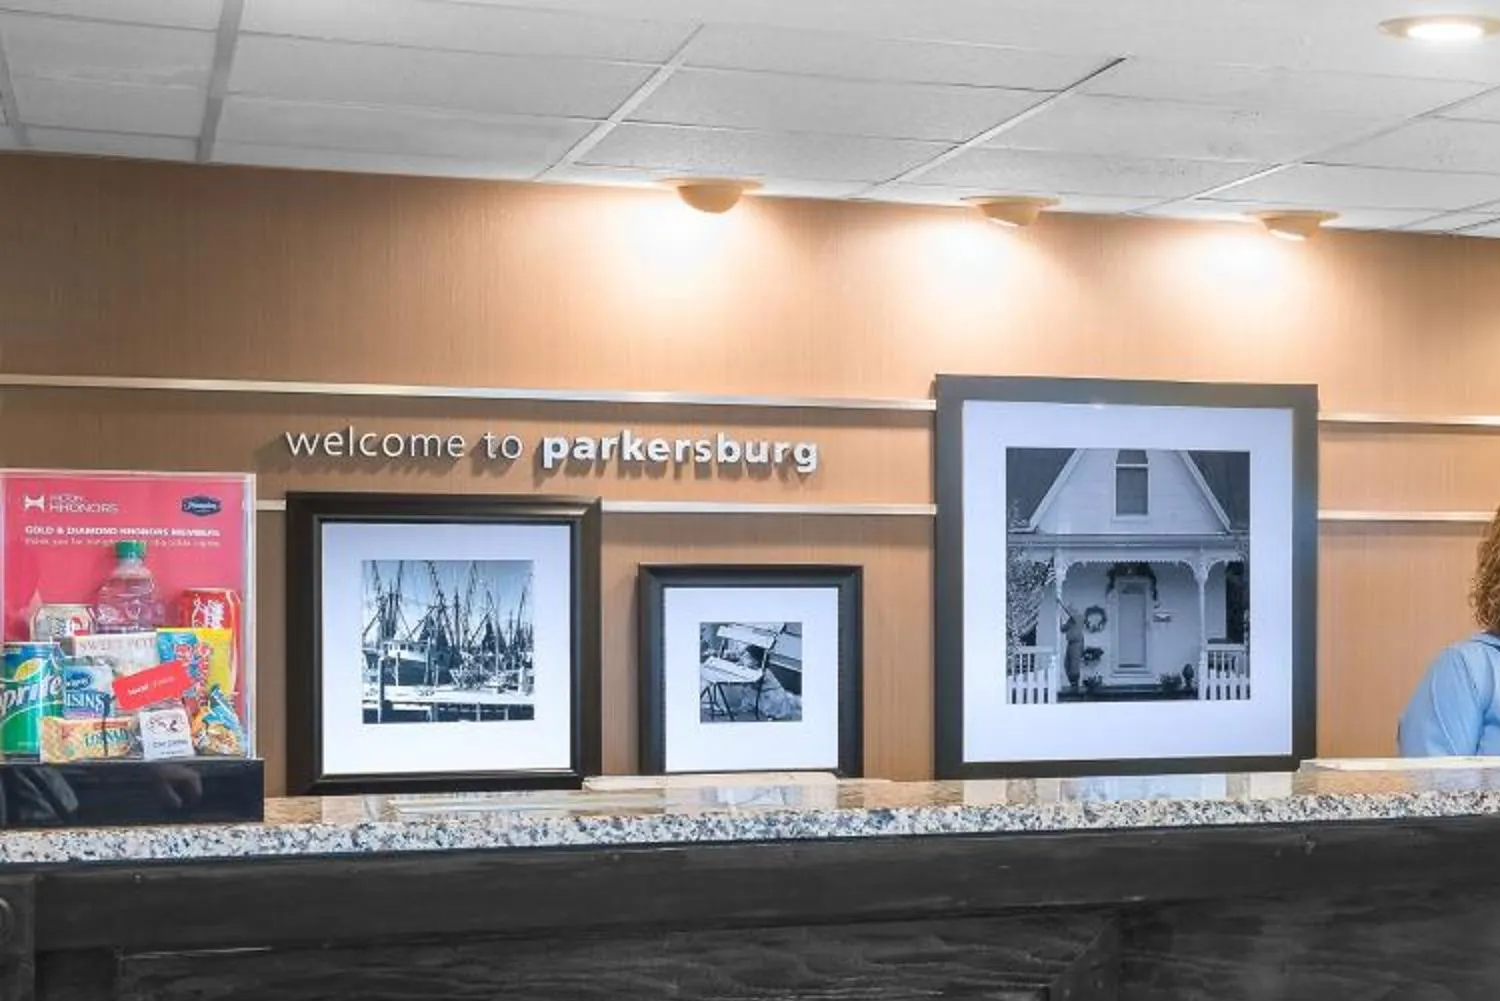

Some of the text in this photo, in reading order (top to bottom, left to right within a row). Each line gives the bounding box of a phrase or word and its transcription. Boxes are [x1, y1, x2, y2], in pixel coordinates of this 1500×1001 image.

[285, 426, 818, 473] welcome to parkersburg
[49, 503, 119, 513] HHONORS
[25, 525, 54, 535] GOLD
[67, 527, 117, 536] DIAMOND
[0, 672, 62, 721] prite
